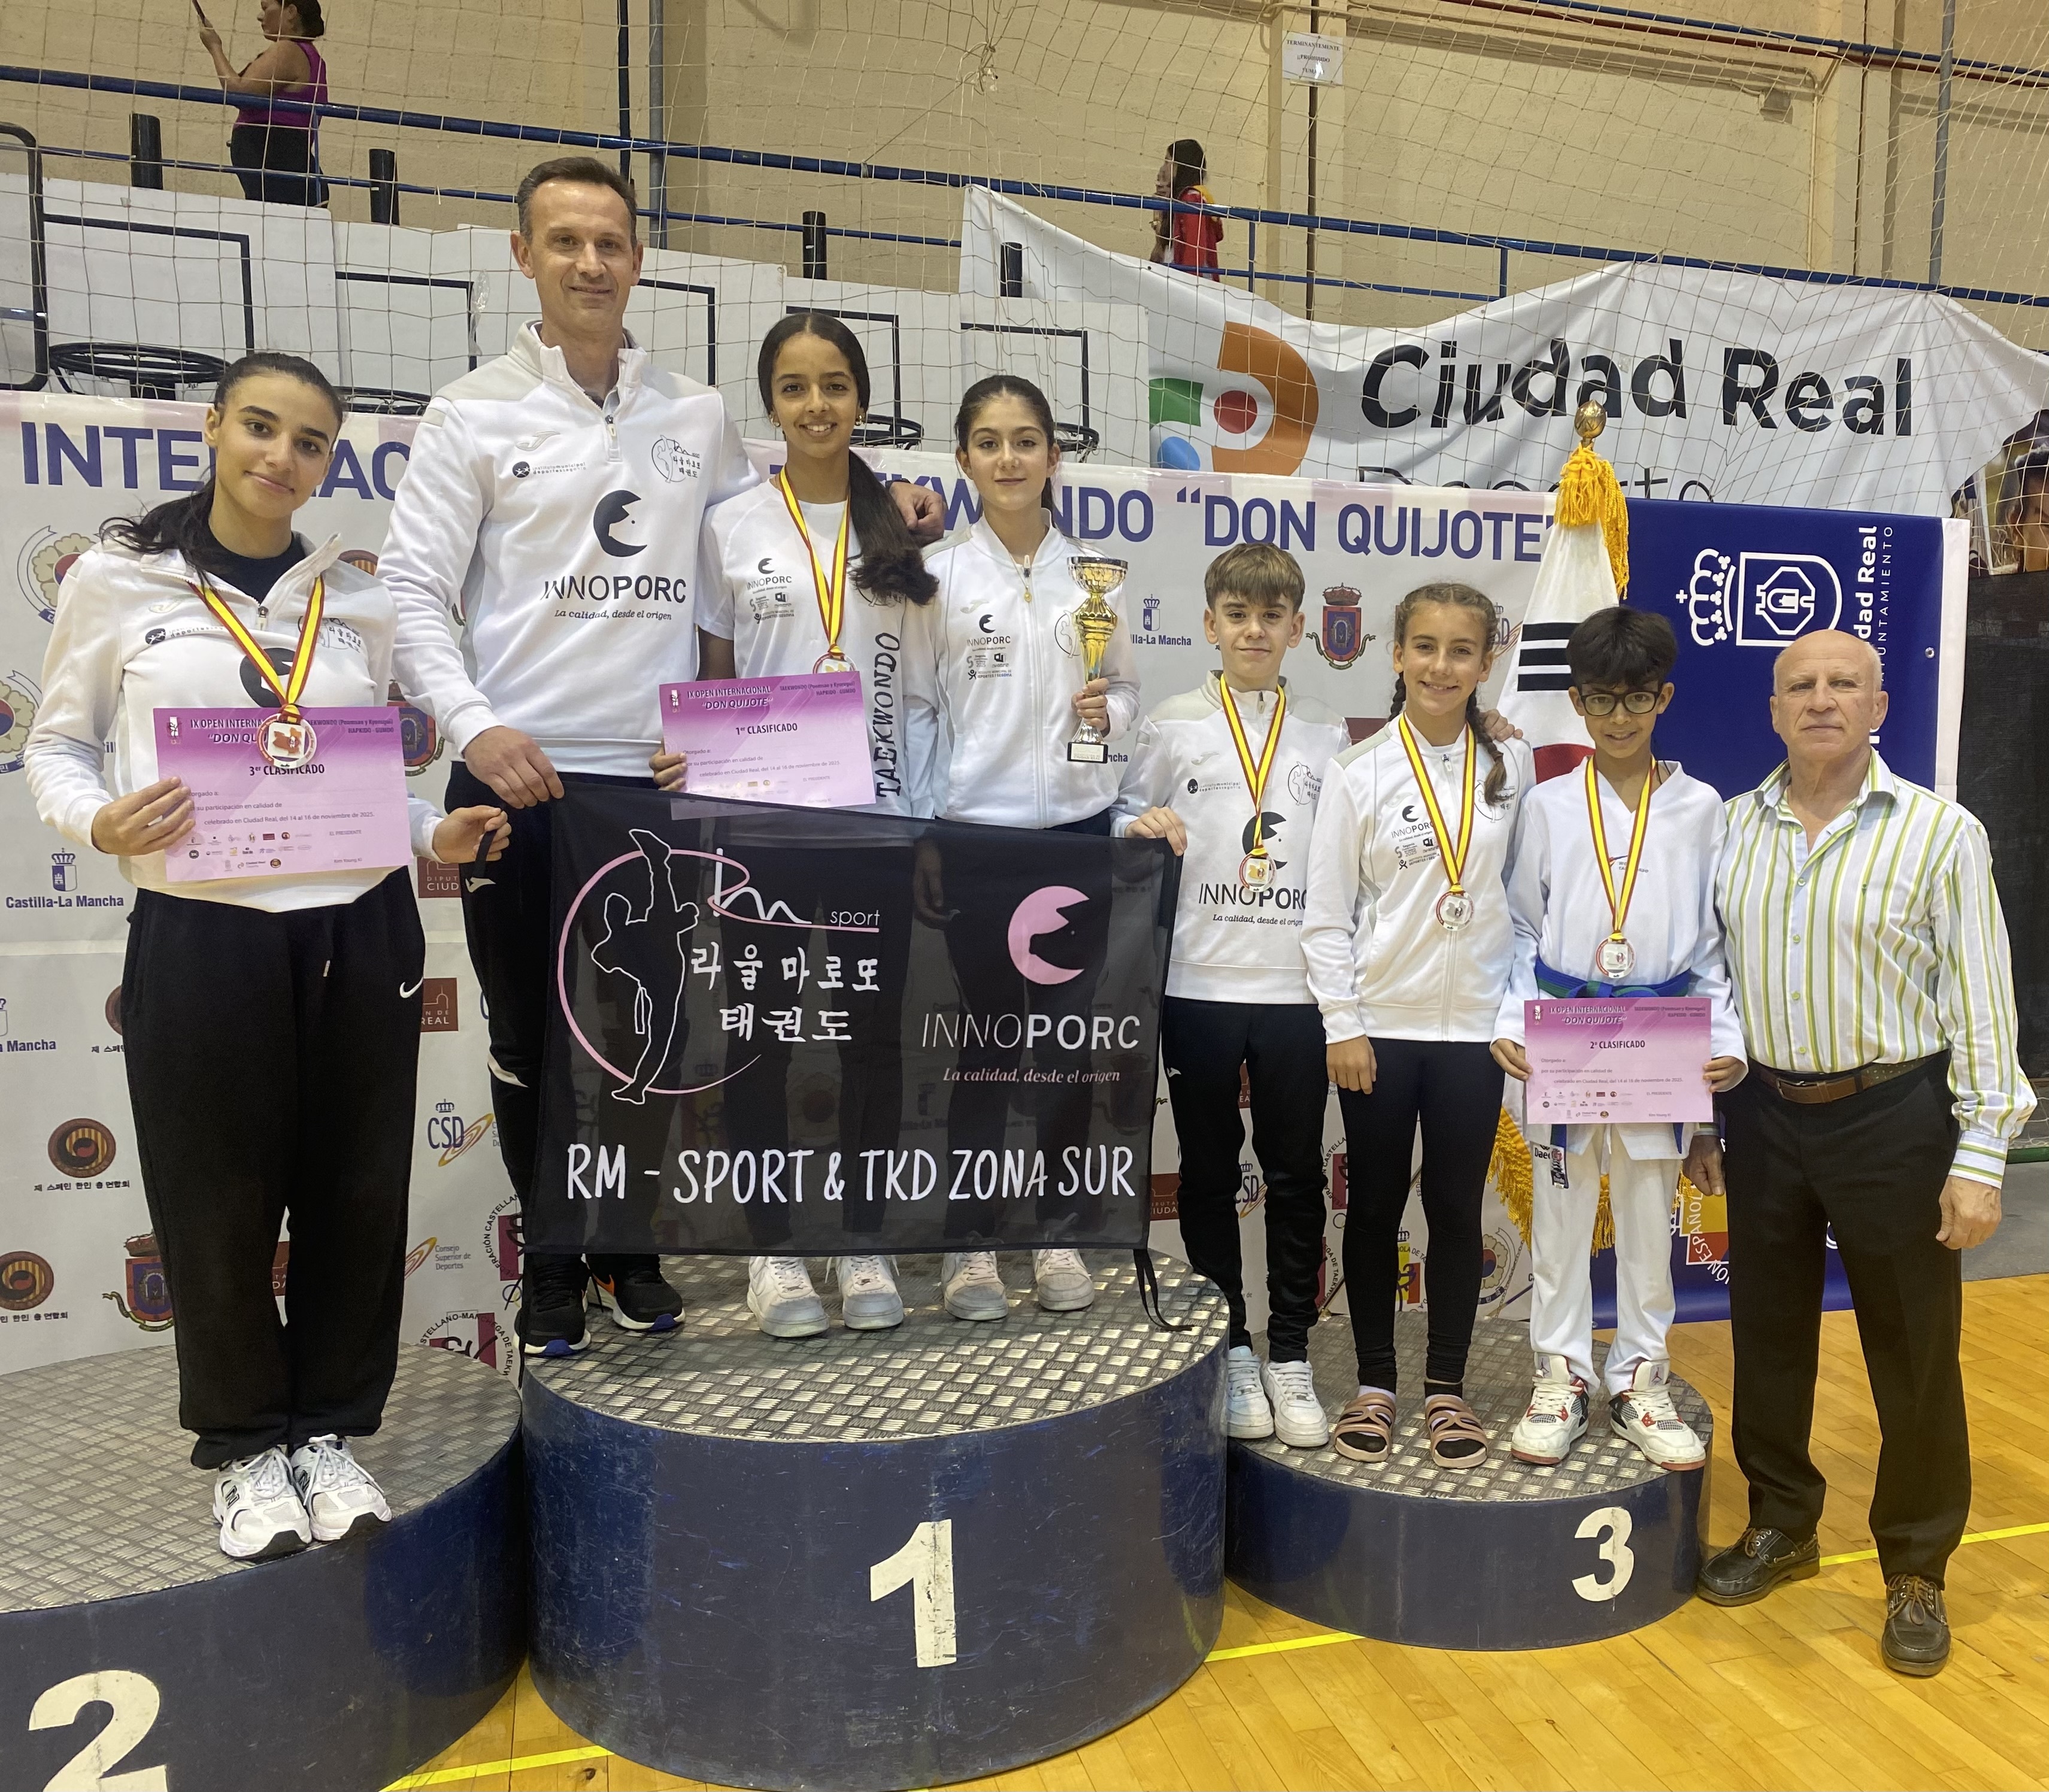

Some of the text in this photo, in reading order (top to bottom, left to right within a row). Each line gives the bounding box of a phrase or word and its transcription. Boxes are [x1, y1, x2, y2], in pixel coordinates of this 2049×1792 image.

[1361, 338, 1912, 436] Ciudad Real
[1857, 525, 1878, 583] Real
[747, 575, 792, 590] INNOPORC
[569, 610, 609, 620] calidad,
[612, 610, 635, 618] desde
[636, 610, 644, 618] el
[646, 611, 672, 620] origen
[966, 635, 1011, 647] INNOPORC
[1159, 635, 1192, 646] Mancha
[695, 689, 714, 698] OPEN
[715, 685, 771, 697] INTERNACIONAL
[872, 632, 902, 798] TAEKWONDO
[190, 718, 225, 729] IX OPEN
[747, 722, 798, 735] CLASIFICADO
[699, 758, 731, 767] participación
[699, 769, 723, 778] celebrado
[5, 895, 125, 908] Castilla-La Mancha
[830, 909, 880, 929] sport
[1224, 915, 1255, 924] calidad,
[1257, 916, 1278, 925] desde
[1574, 1005, 1626, 1014] INTERNACIONAL
[719, 1002, 853, 1042] 태권도
[922, 1012, 1141, 1051] INNOPORC
[7, 1039, 56, 1053] Mancha
[1599, 1039, 1645, 1049] CLASIFICADO
[943, 1068, 1120, 1084] La calidad, desde el origen
[427, 1116, 464, 1150] CSD
[567, 1143, 626, 1199] RM
[673, 1148, 815, 1204] SPORT
[823, 1151, 845, 1202] &
[859, 1148, 937, 1200] TKD
[948, 1148, 1048, 1200] ZONA
[1057, 1144, 1136, 1197] SUR
[435, 1244, 460, 1254] Consejo
[435, 1253, 462, 1262] Superior
[435, 1261, 464, 1271] Deportes
[502, 1335, 512, 1348] DE
[1571, 1506, 1635, 1602] 3
[869, 1518, 957, 1668] 1
[28, 1669, 168, 1792] 2
